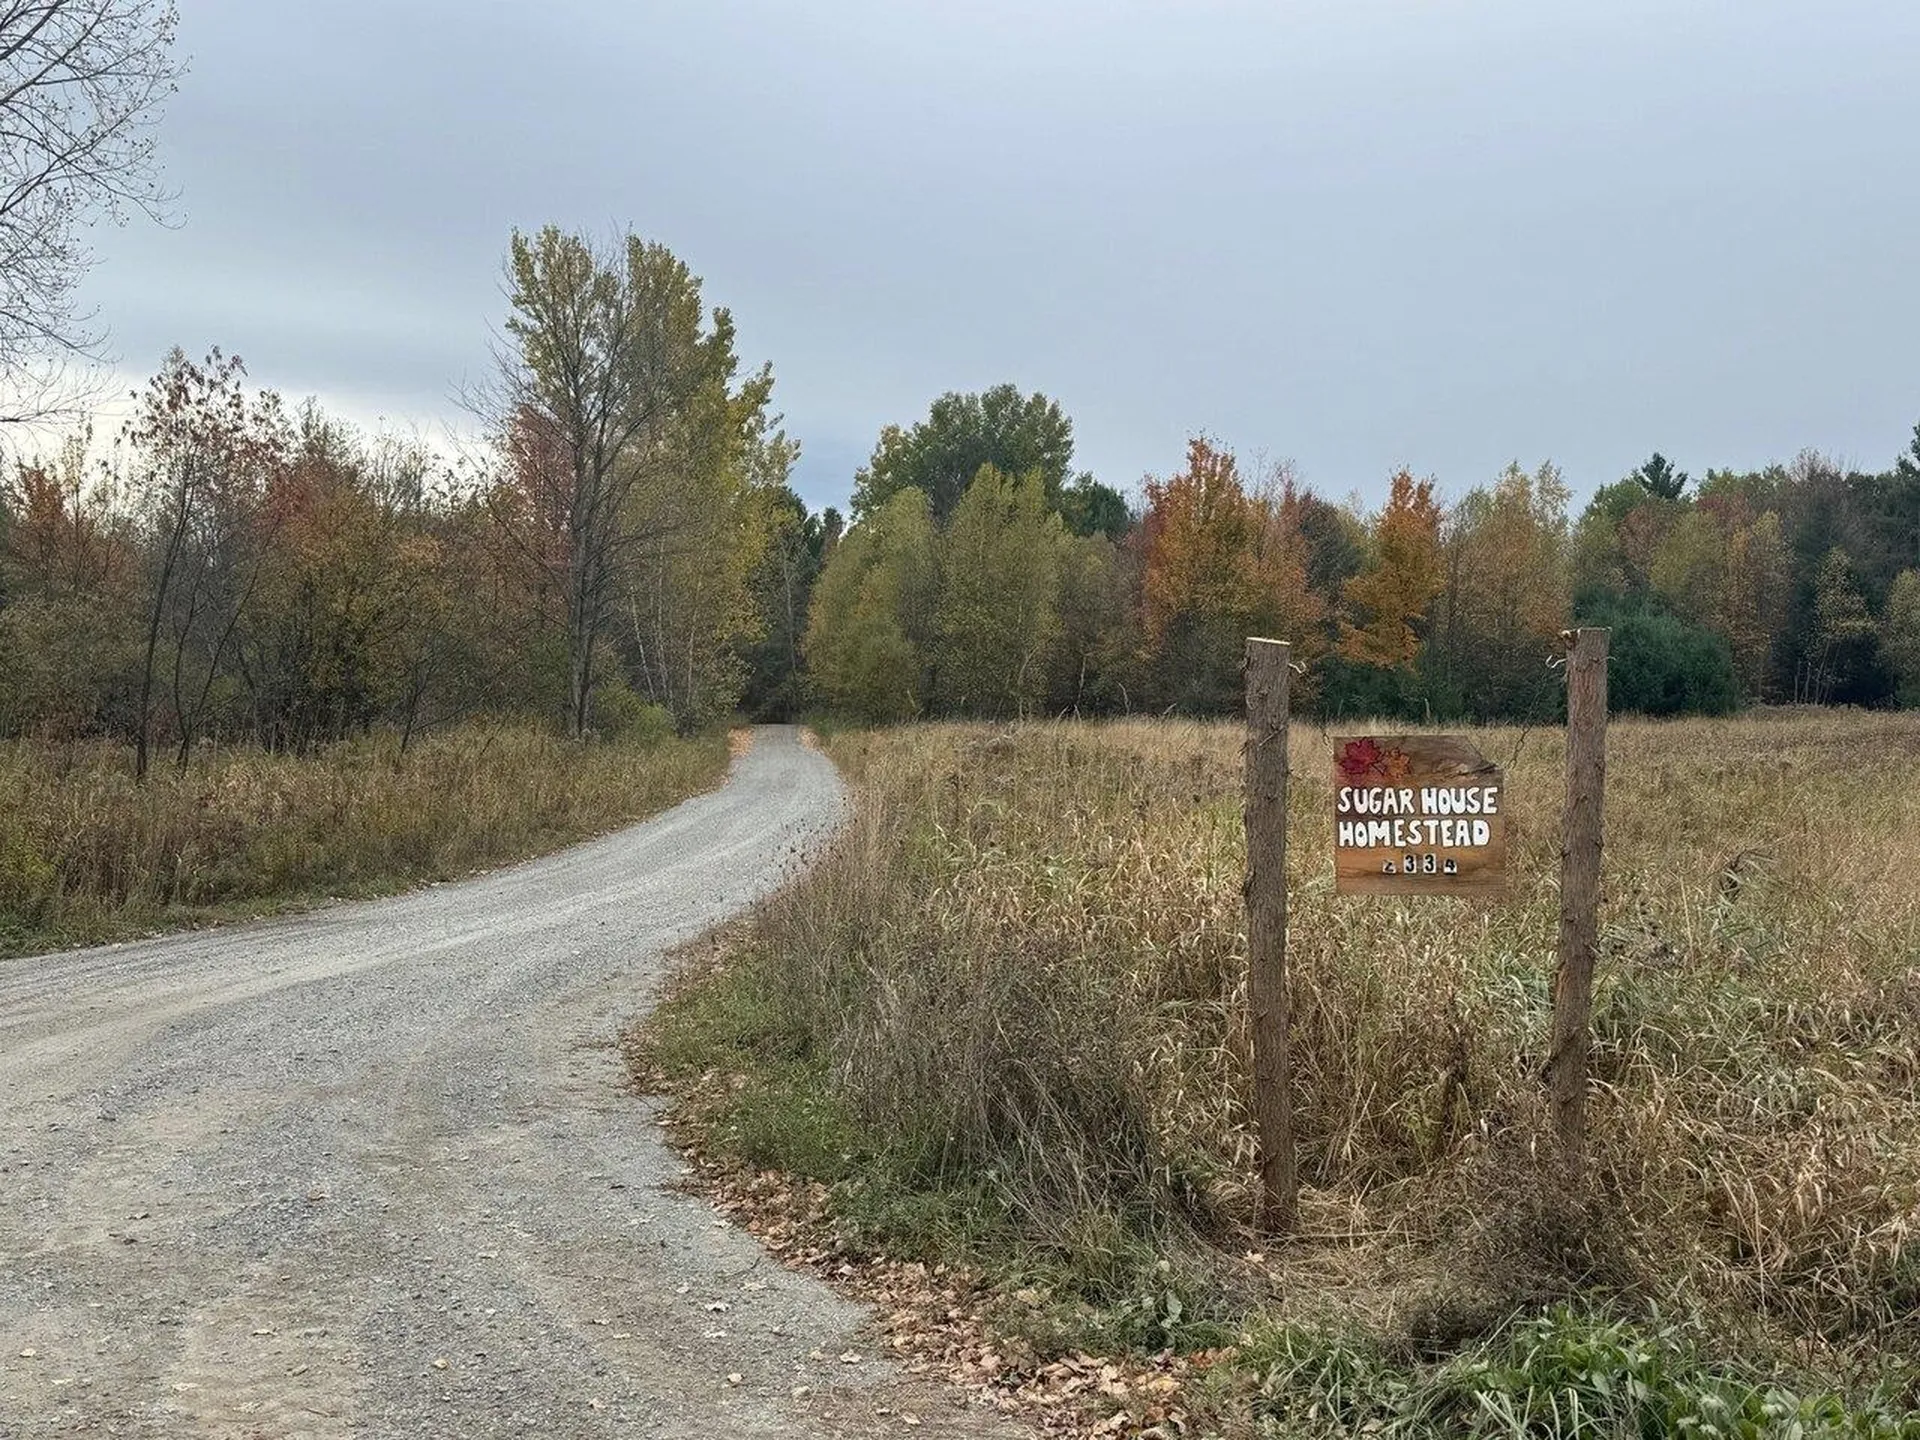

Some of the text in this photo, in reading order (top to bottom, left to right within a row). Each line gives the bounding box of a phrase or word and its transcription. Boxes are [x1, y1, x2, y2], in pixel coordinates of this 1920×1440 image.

[1337, 787, 1498, 815] SUGAR HOUSE
[1338, 819, 1490, 847] HOMESTEAD
